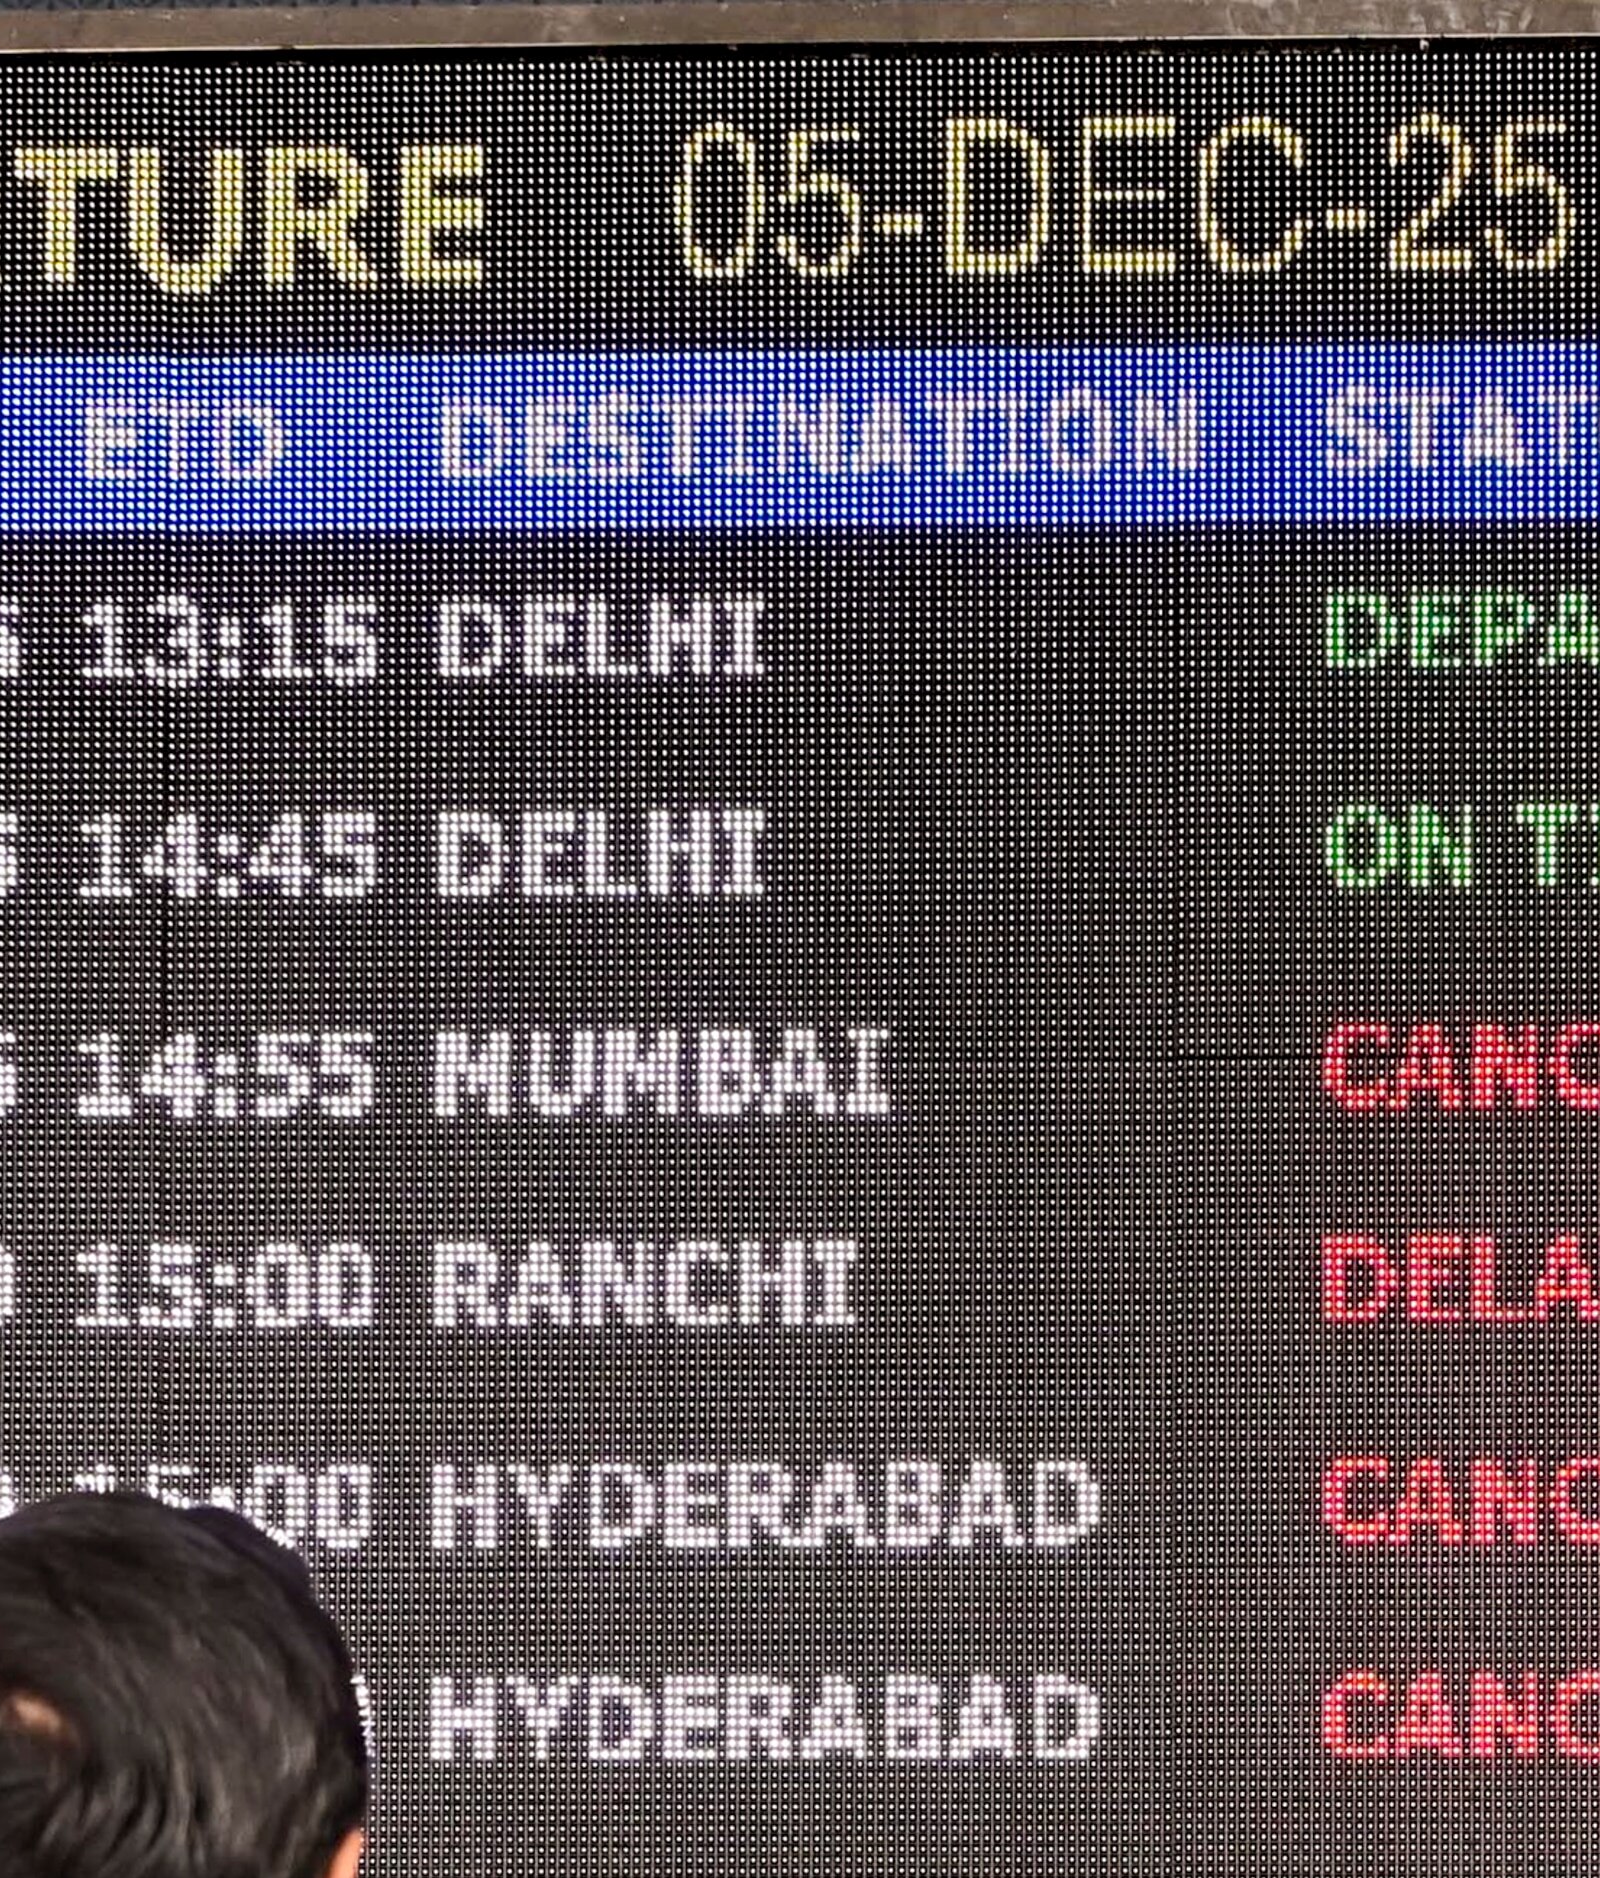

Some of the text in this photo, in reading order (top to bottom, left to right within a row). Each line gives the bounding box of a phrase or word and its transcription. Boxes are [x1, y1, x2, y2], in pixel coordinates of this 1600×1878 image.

[676, 112, 1579, 280] 05-DEC-25
[81, 395, 288, 483] ETD
[437, 384, 1199, 481] DESTINATION
[81, 594, 379, 688] 13:15
[436, 590, 768, 680] DELHI
[79, 808, 379, 900] 14:45
[434, 805, 768, 897] DELHI
[1321, 800, 1477, 890] ON
[74, 1029, 377, 1119] 14:55
[431, 1026, 894, 1117] MUMBAI
[73, 1240, 375, 1329] 15:00
[431, 1238, 862, 1330] RANCHI
[430, 1458, 1104, 1552] HYDERABAD
[428, 1670, 1104, 1764] HYDERABAD
